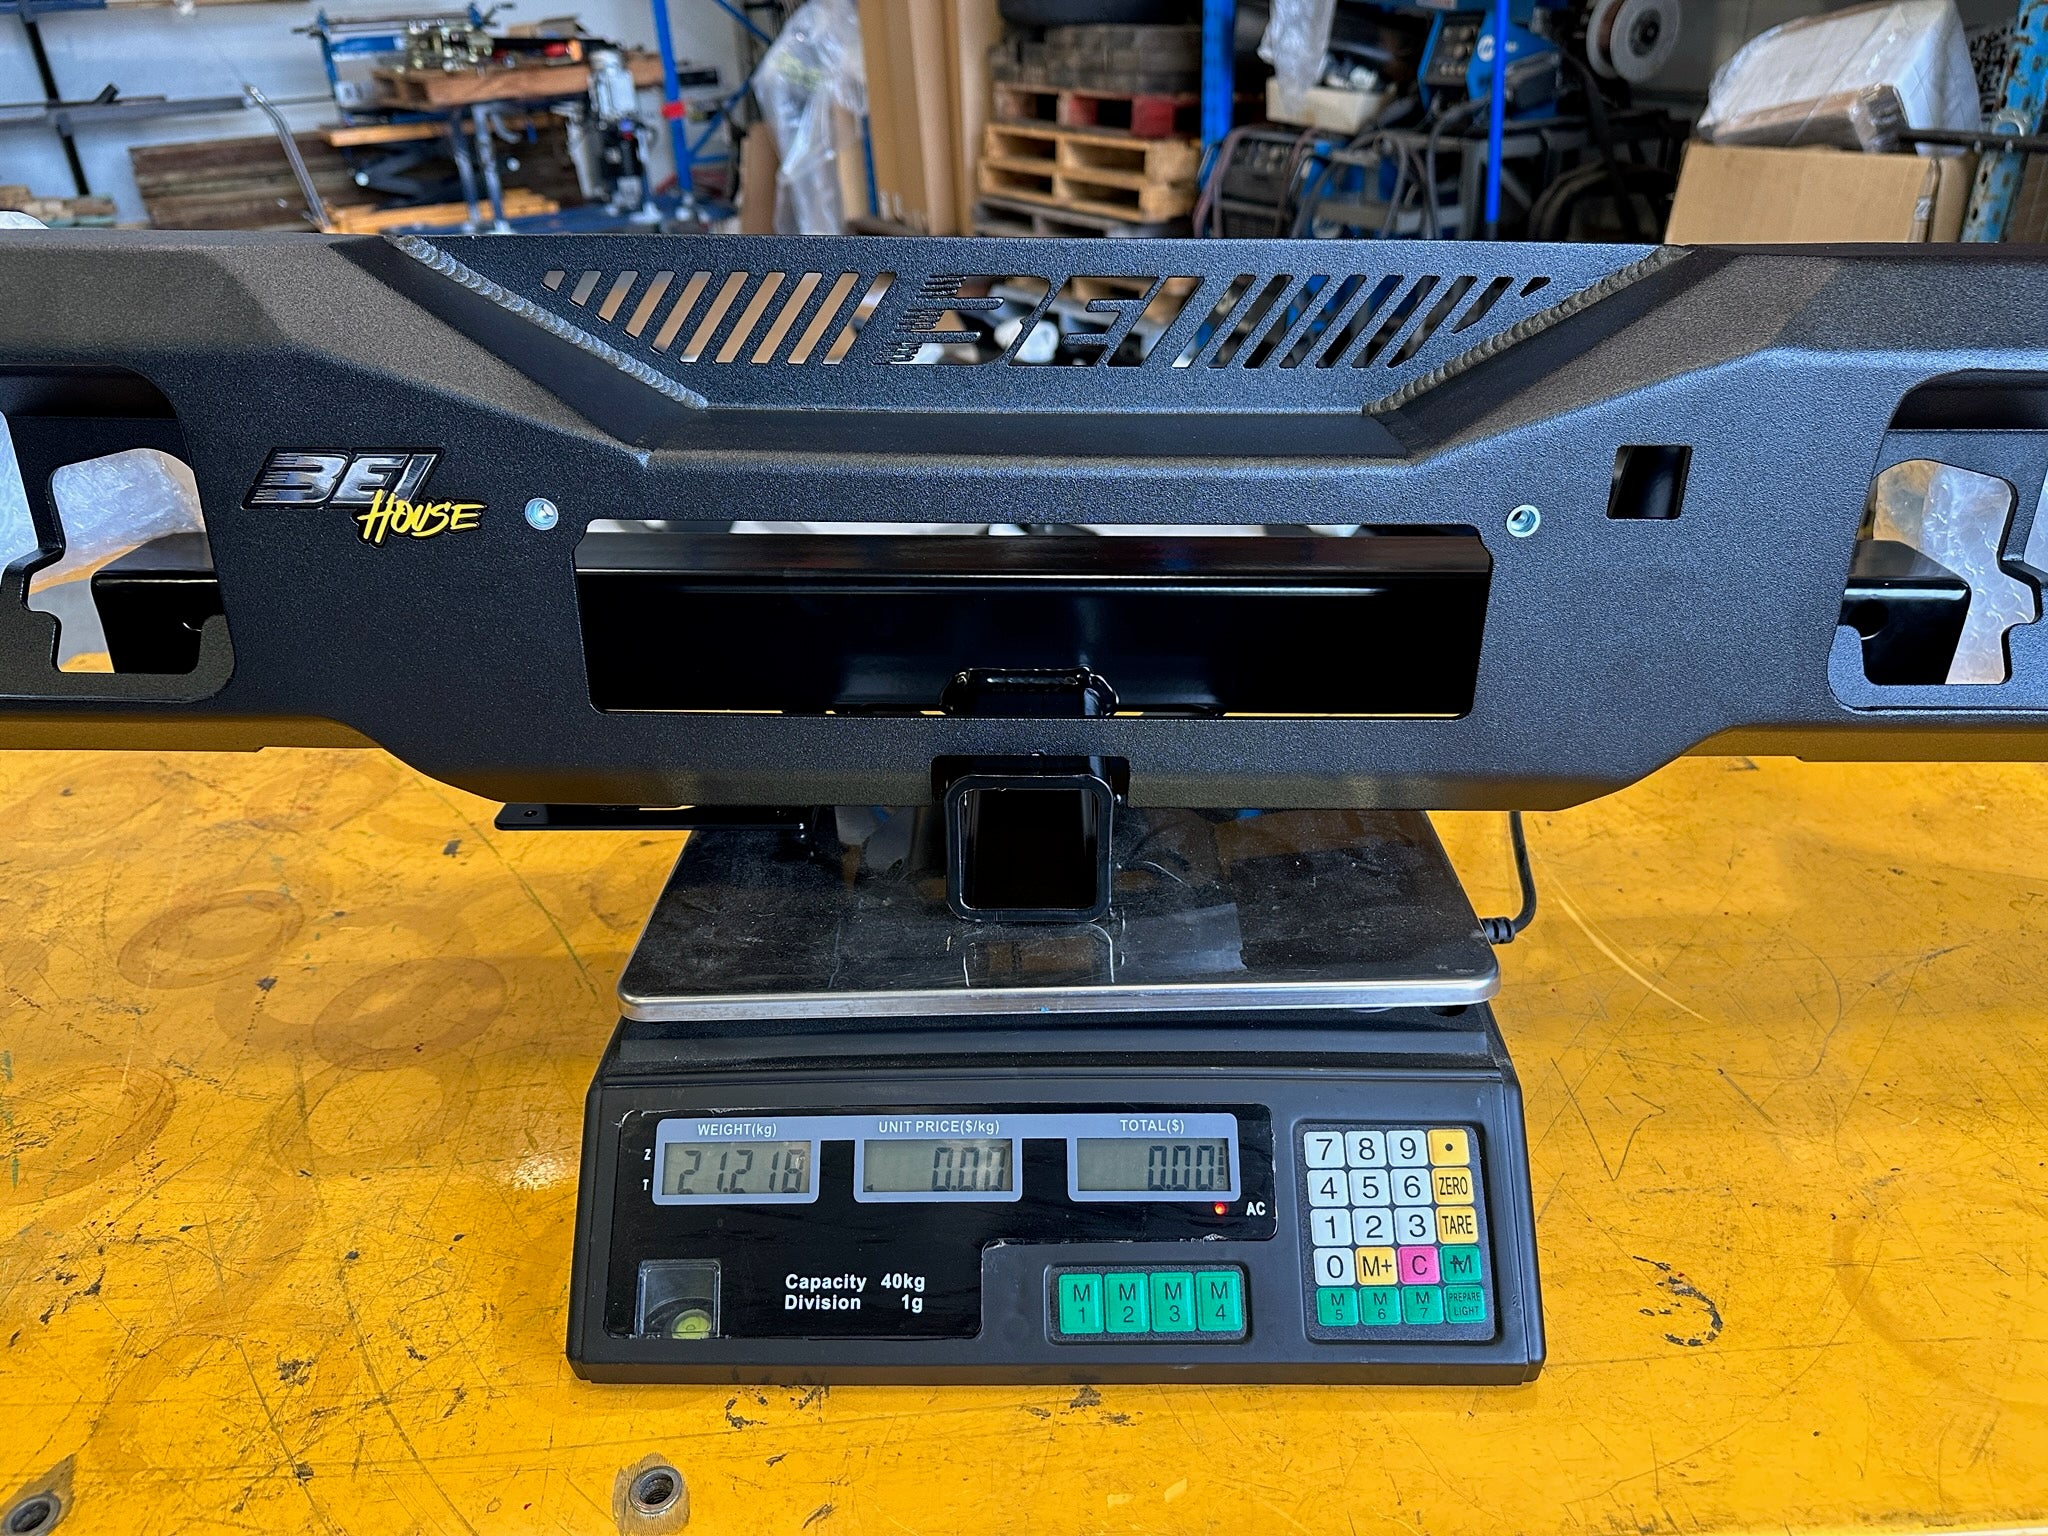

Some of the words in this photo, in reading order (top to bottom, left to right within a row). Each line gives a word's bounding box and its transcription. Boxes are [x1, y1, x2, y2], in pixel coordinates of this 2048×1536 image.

[357, 488, 486, 544] HOUSE
[697, 1122, 777, 1138] WEIGHT(kg)
[878, 1120, 912, 1133] UNIT
[915, 1119, 1000, 1135] PRICE($/kg)
[1119, 1119, 1185, 1134] TOTAL($)
[643, 1148, 652, 1161] Z
[1316, 1138, 1333, 1161] 7
[1358, 1137, 1376, 1160] 8
[1400, 1137, 1417, 1160] 9
[677, 1149, 805, 1195] 21.218
[931, 1146, 1006, 1192] 0.00
[1147, 1145, 1215, 1191] 0.00
[642, 1178, 650, 1191] T
[1320, 1176, 1338, 1200] 4
[1362, 1176, 1379, 1199] 5
[1403, 1175, 1421, 1198] 6
[1438, 1176, 1468, 1196] ZERO
[1246, 1201, 1266, 1216] AC
[1325, 1215, 1336, 1239] 1
[1365, 1215, 1383, 1239] 2
[1408, 1214, 1426, 1238] 3
[1441, 1214, 1474, 1235] TARE
[1362, 1255, 1393, 1277] M+
[1411, 1255, 1427, 1276] C
[785, 1273, 867, 1293] Capacity
[880, 1272, 926, 1293] 40kg
[1119, 1282, 1136, 1301] M
[1164, 1281, 1182, 1300] M
[1210, 1281, 1228, 1300] M
[1073, 1283, 1091, 1302] M
[1330, 1292, 1345, 1306] M
[1373, 1292, 1387, 1306] M
[1415, 1291, 1430, 1305] M
[1448, 1291, 1481, 1302] PREPARE
[784, 1294, 861, 1311] Division
[901, 1293, 923, 1314] 1g
[1169, 1304, 1181, 1322] 3
[1215, 1303, 1226, 1321] 4
[1420, 1307, 1428, 1319] 7
[1453, 1305, 1480, 1317] LIGHT
[1078, 1307, 1086, 1324] 1
[1123, 1305, 1134, 1323] 2
[1335, 1308, 1344, 1321] 5
[1377, 1308, 1387, 1320] 6
